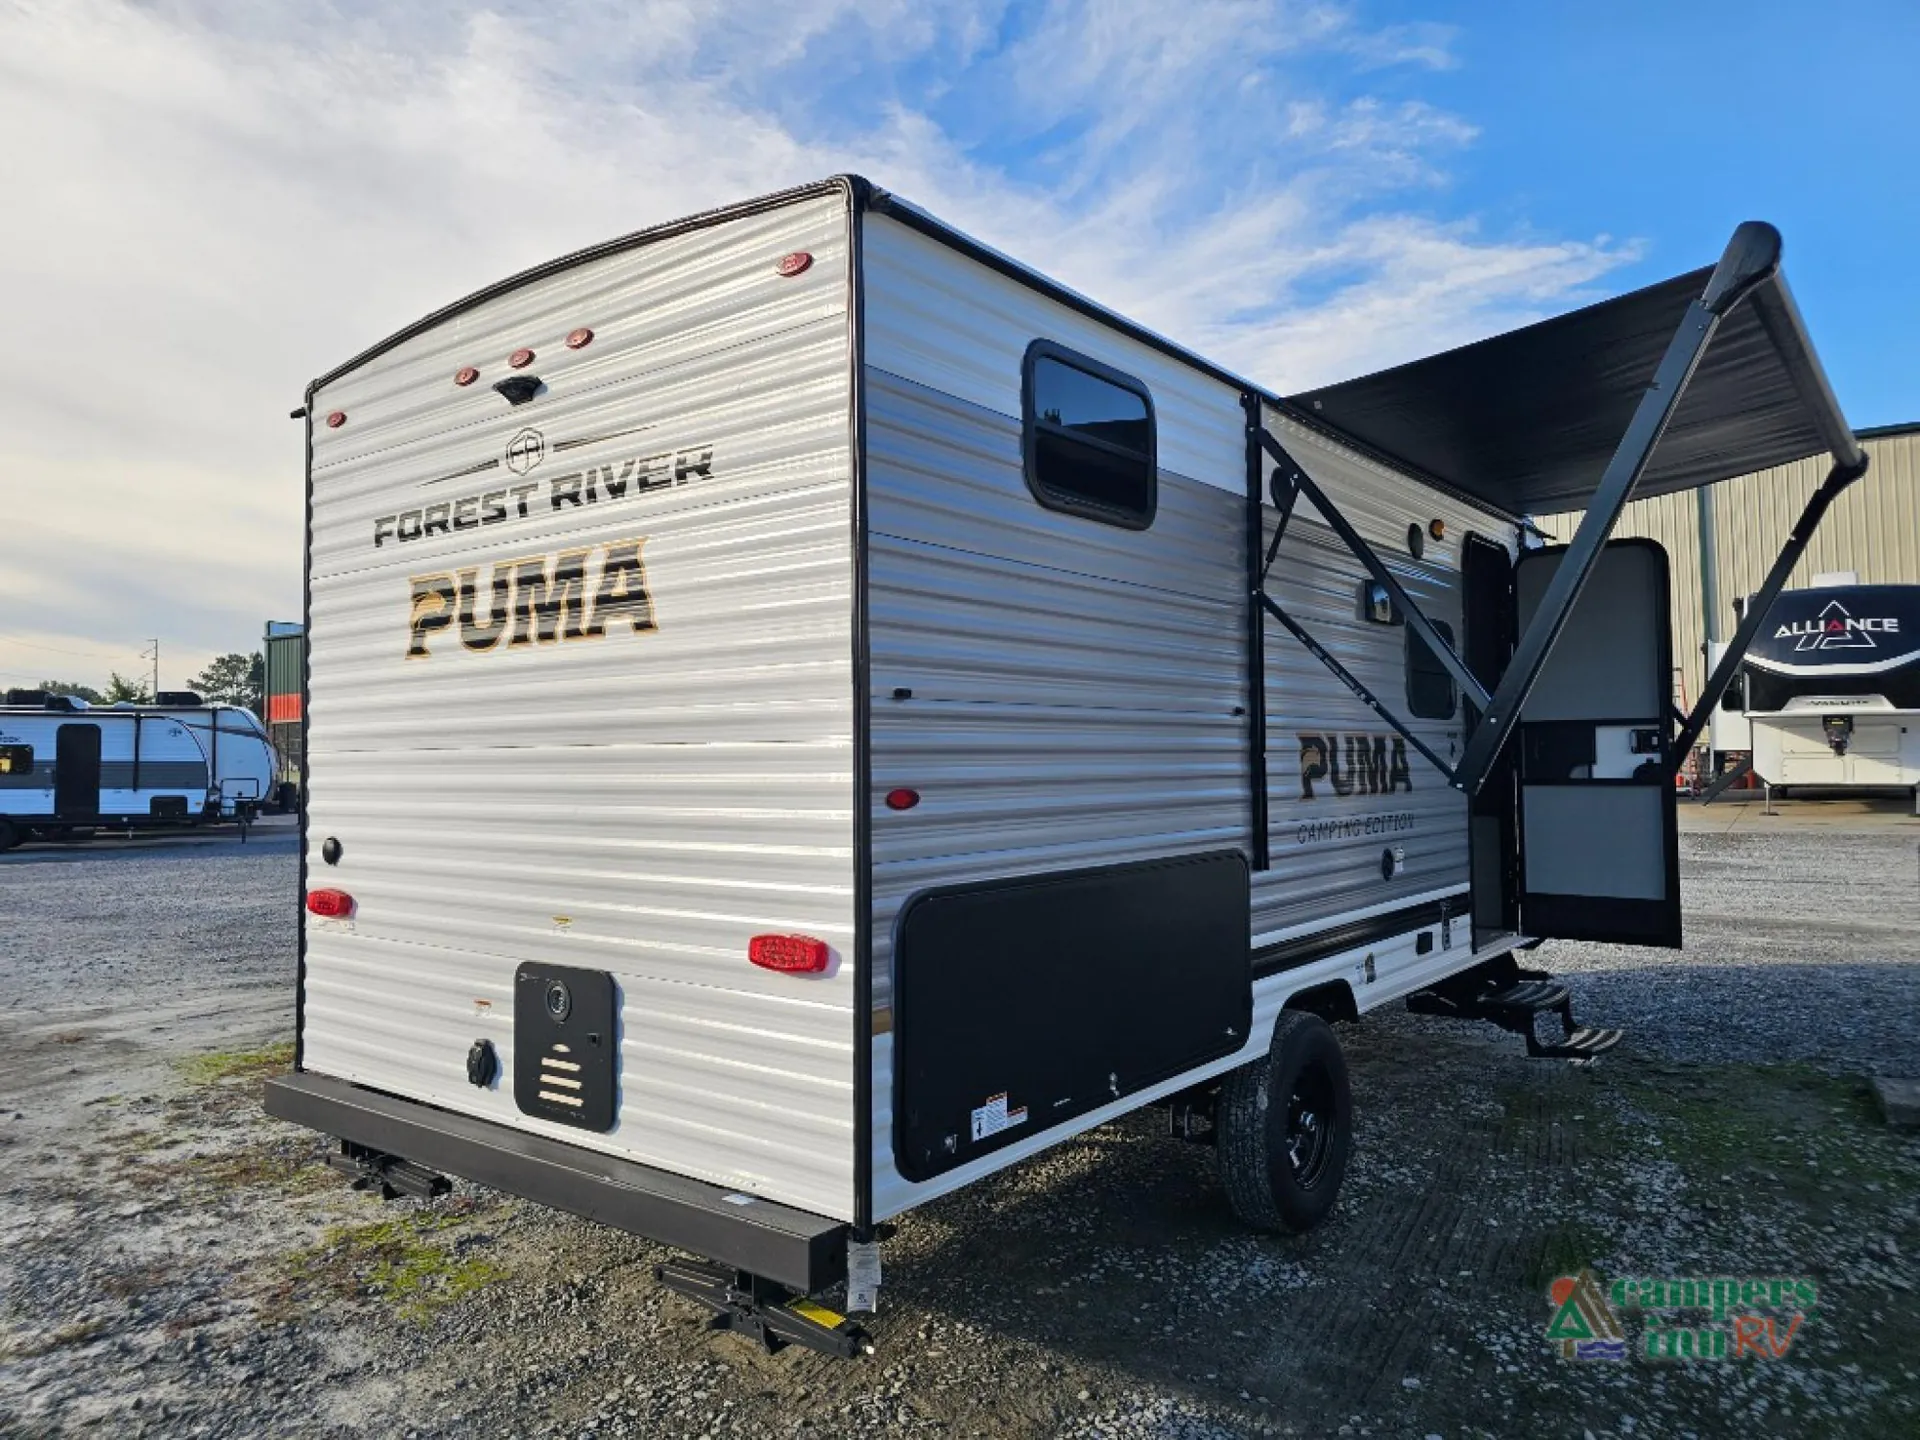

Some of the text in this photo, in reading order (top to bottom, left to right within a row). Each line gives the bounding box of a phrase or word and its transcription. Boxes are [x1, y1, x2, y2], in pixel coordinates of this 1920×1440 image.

[374, 444, 714, 548] FOREST RIVER
[405, 537, 659, 660] PUMA
[1773, 617, 1900, 639] ALLIANCE
[1295, 732, 1413, 802] PUMA
[1297, 813, 1415, 845] CAMPING EDITION
